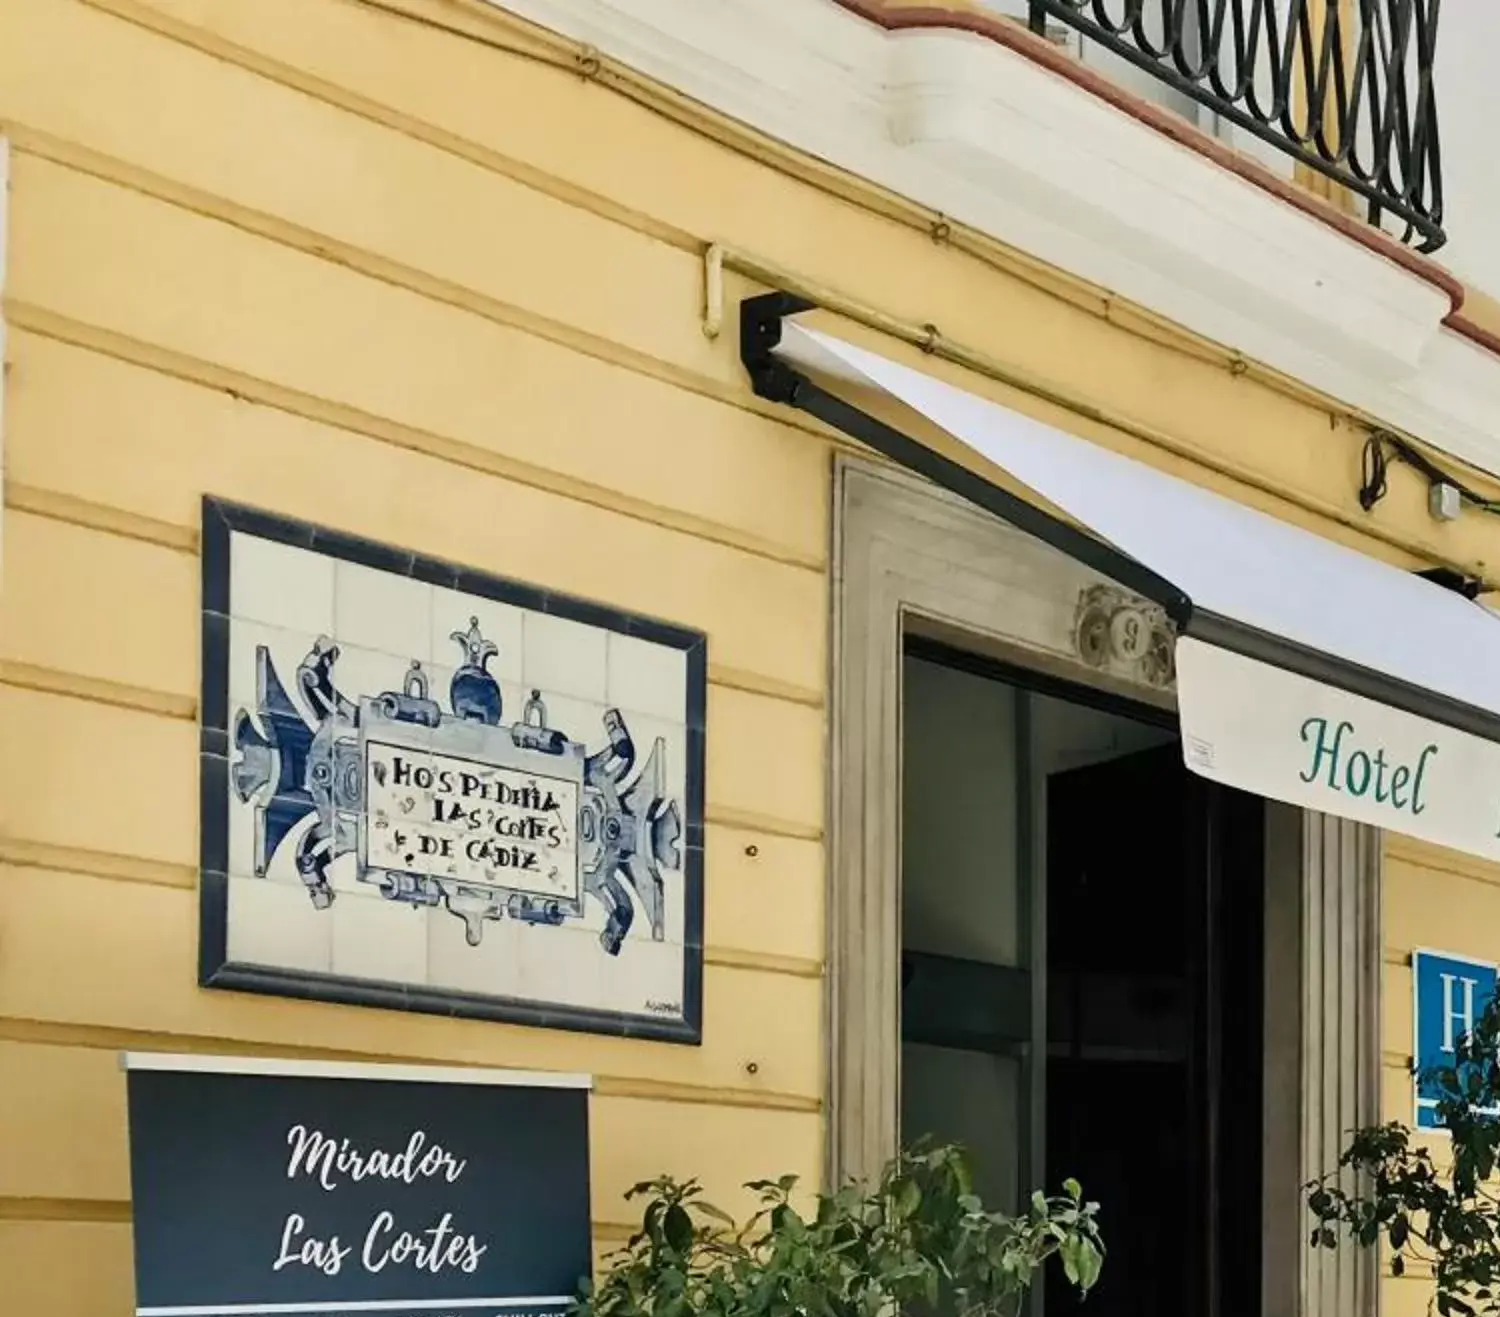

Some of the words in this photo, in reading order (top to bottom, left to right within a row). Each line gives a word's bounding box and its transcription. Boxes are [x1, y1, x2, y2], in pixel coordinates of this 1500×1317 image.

[1299, 717, 1438, 815] Hotel
[418, 833, 454, 858] DE
[432, 799, 482, 830] LAS
[494, 815, 560, 848] CORTES
[1439, 973, 1478, 1053] H
[287, 1125, 467, 1190] Mirador
[273, 1213, 351, 1275] Las
[362, 1211, 487, 1273] Cortes
